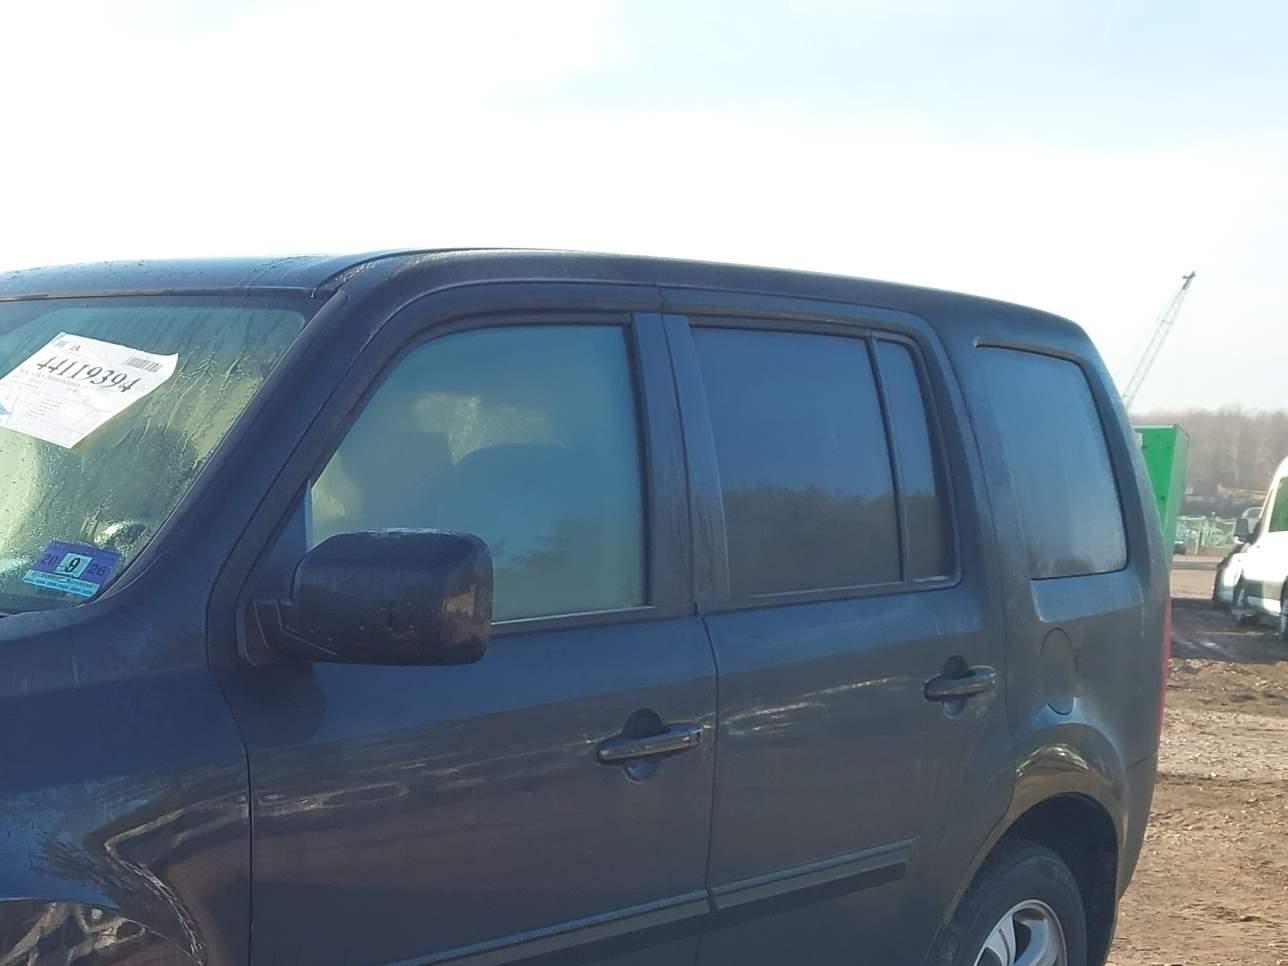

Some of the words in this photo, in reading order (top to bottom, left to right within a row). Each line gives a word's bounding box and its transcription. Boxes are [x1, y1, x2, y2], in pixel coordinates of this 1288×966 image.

[37, 356, 143, 393] 44119394
[64, 557, 81, 573] 9
[87, 563, 106, 577] 26
